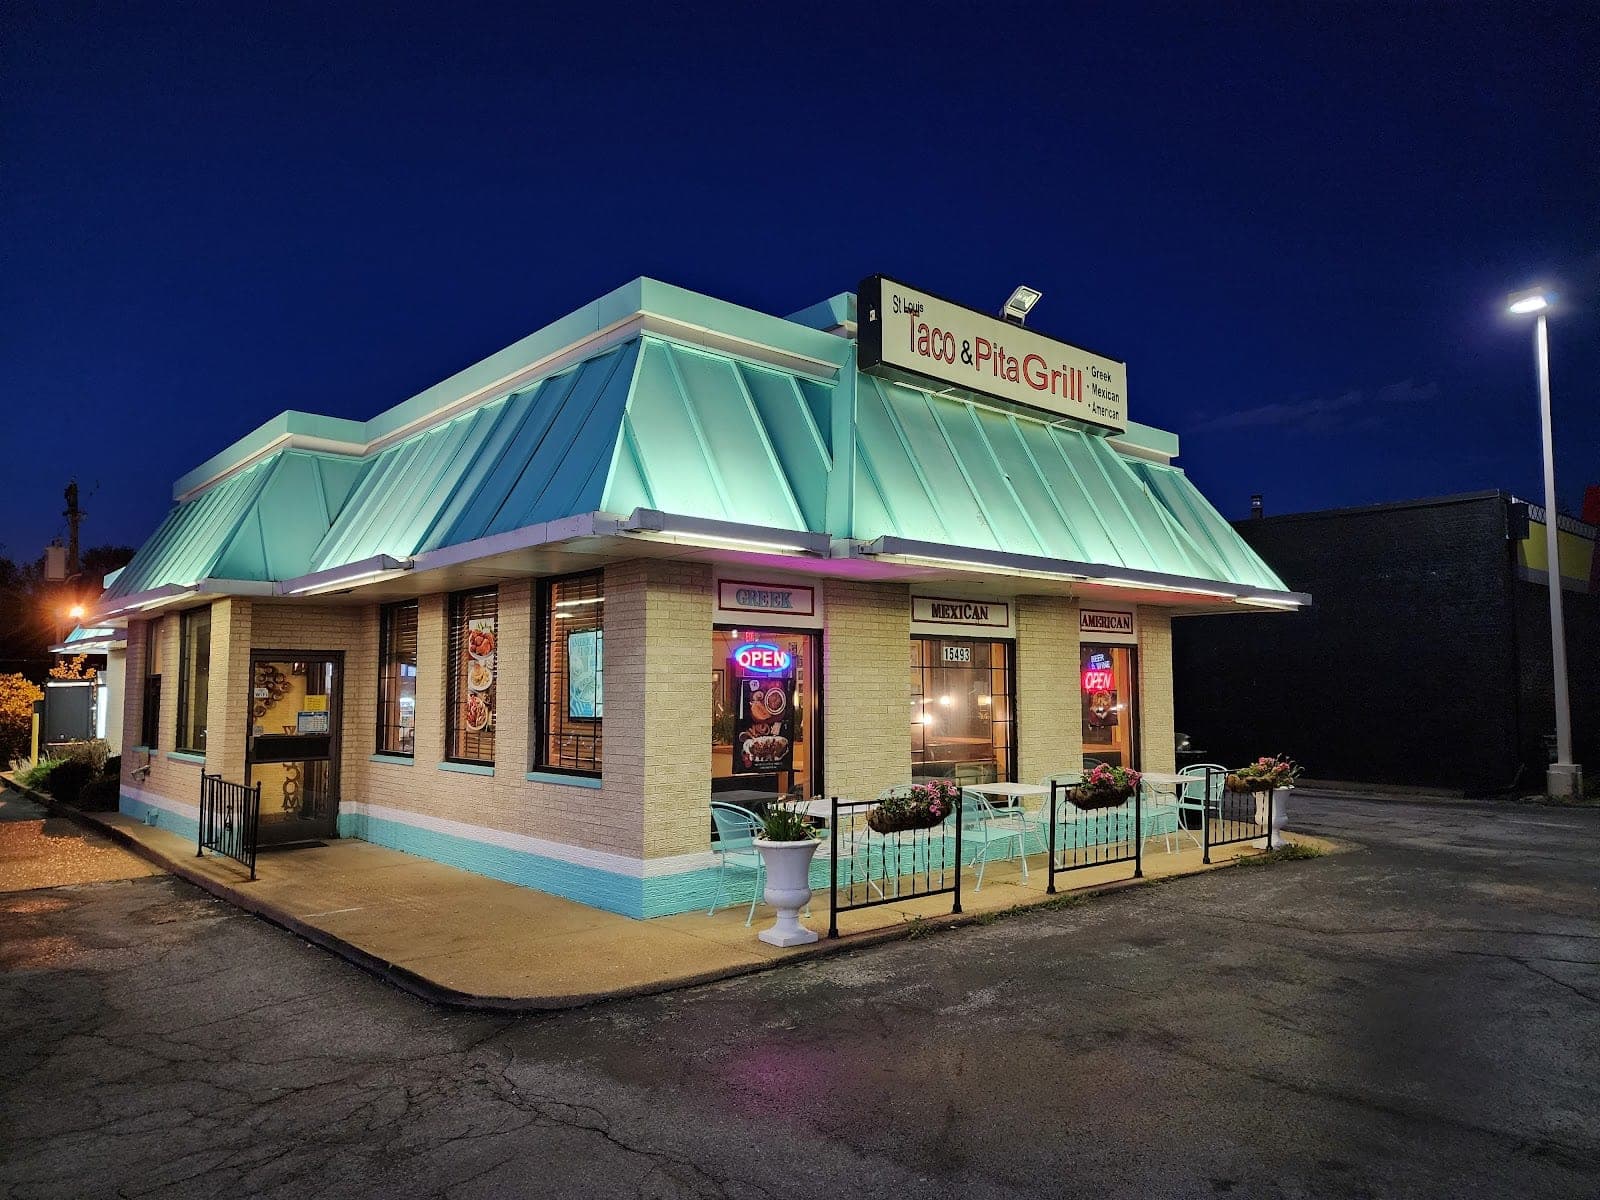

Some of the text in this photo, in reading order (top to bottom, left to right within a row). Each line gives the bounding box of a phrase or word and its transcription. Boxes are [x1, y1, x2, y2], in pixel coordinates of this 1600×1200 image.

[893, 294, 924, 314] St Louis
[905, 308, 1083, 403] Taco & Pita Grill
[1091, 365, 1112, 383] Greek
[1091, 383, 1120, 403] Mexican
[735, 588, 793, 609] GREEK
[931, 603, 989, 621] MEXICAN
[1082, 614, 1130, 630] AMERICAN
[738, 651, 785, 667] OPEN
[944, 647, 970, 661] 15493
[1085, 671, 1112, 689] OPEN
